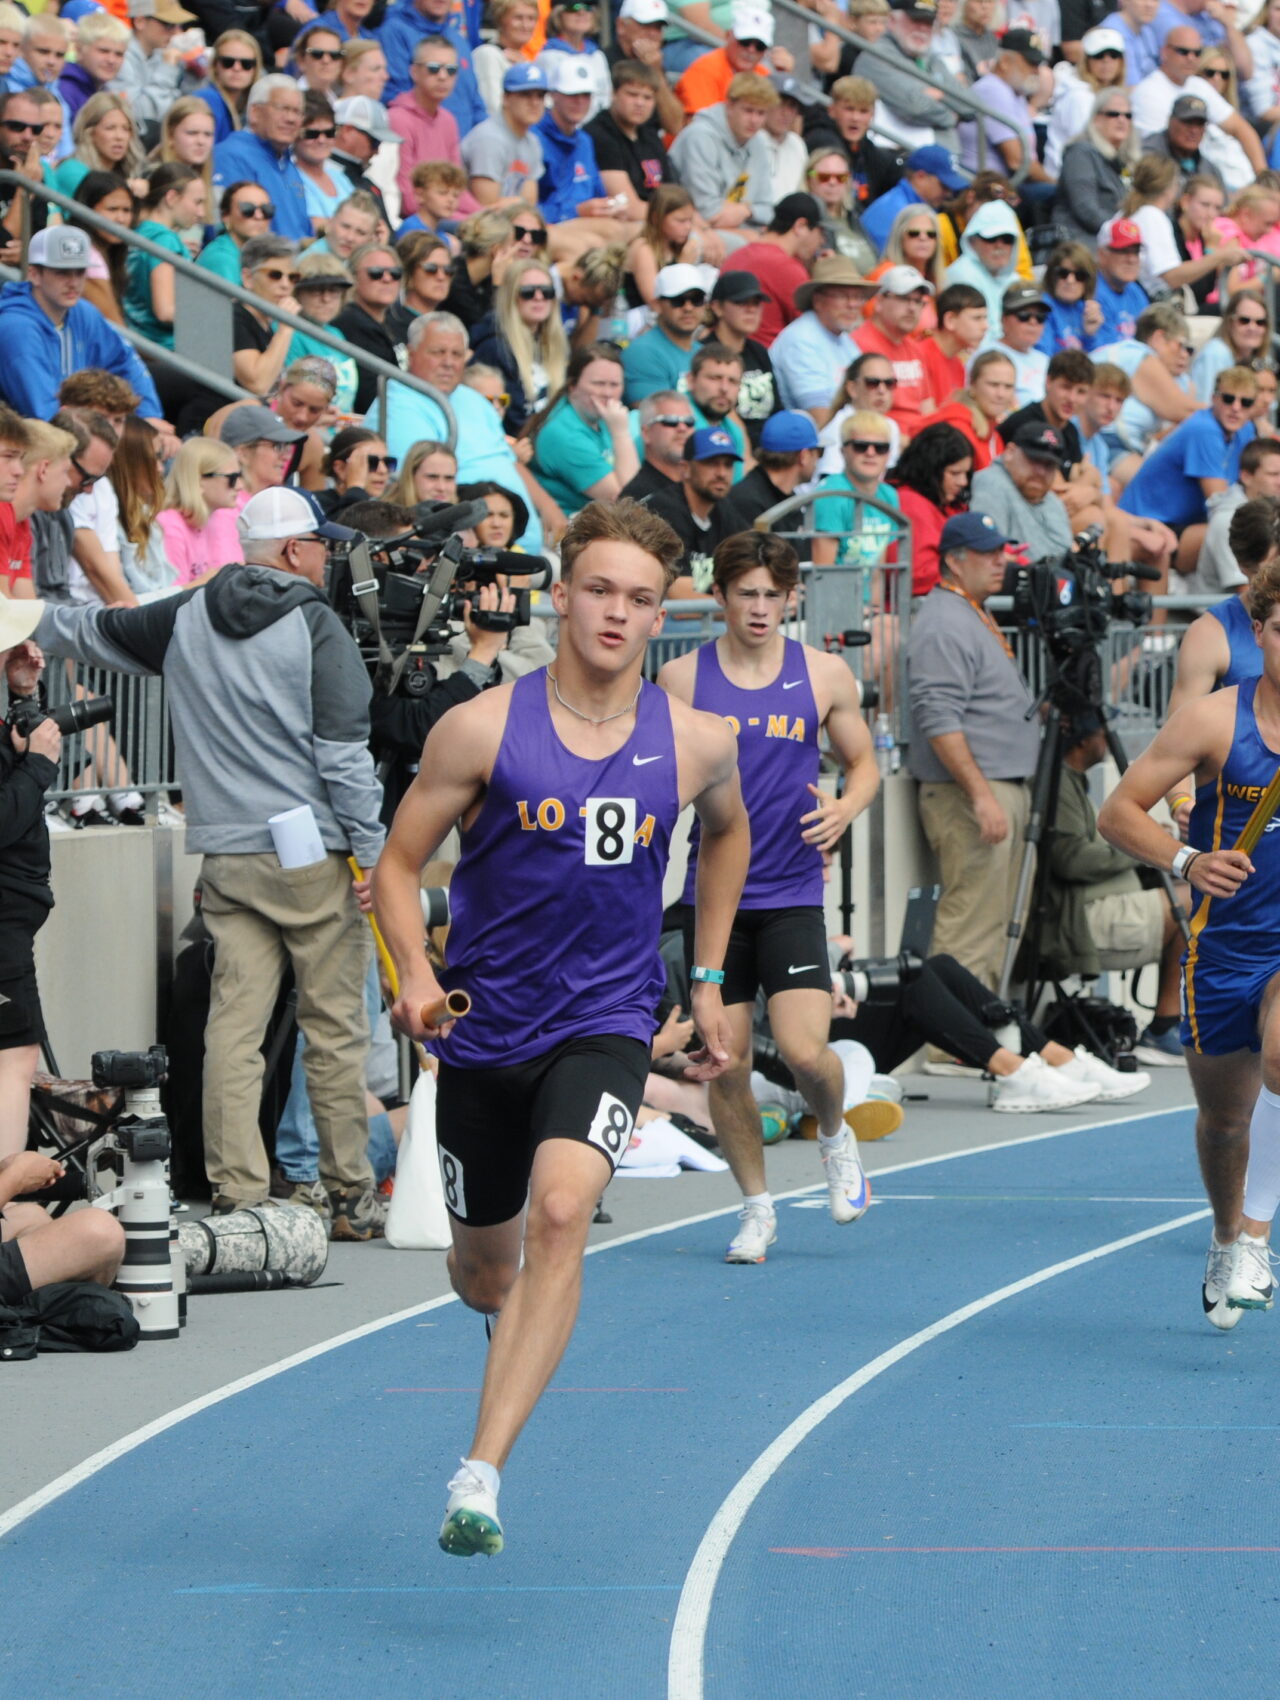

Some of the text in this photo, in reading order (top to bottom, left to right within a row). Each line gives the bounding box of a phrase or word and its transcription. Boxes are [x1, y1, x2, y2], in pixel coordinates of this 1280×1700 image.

[595, 801, 626, 862] 8
[601, 1103, 628, 1154] 8
[442, 1154, 458, 1209] 8
